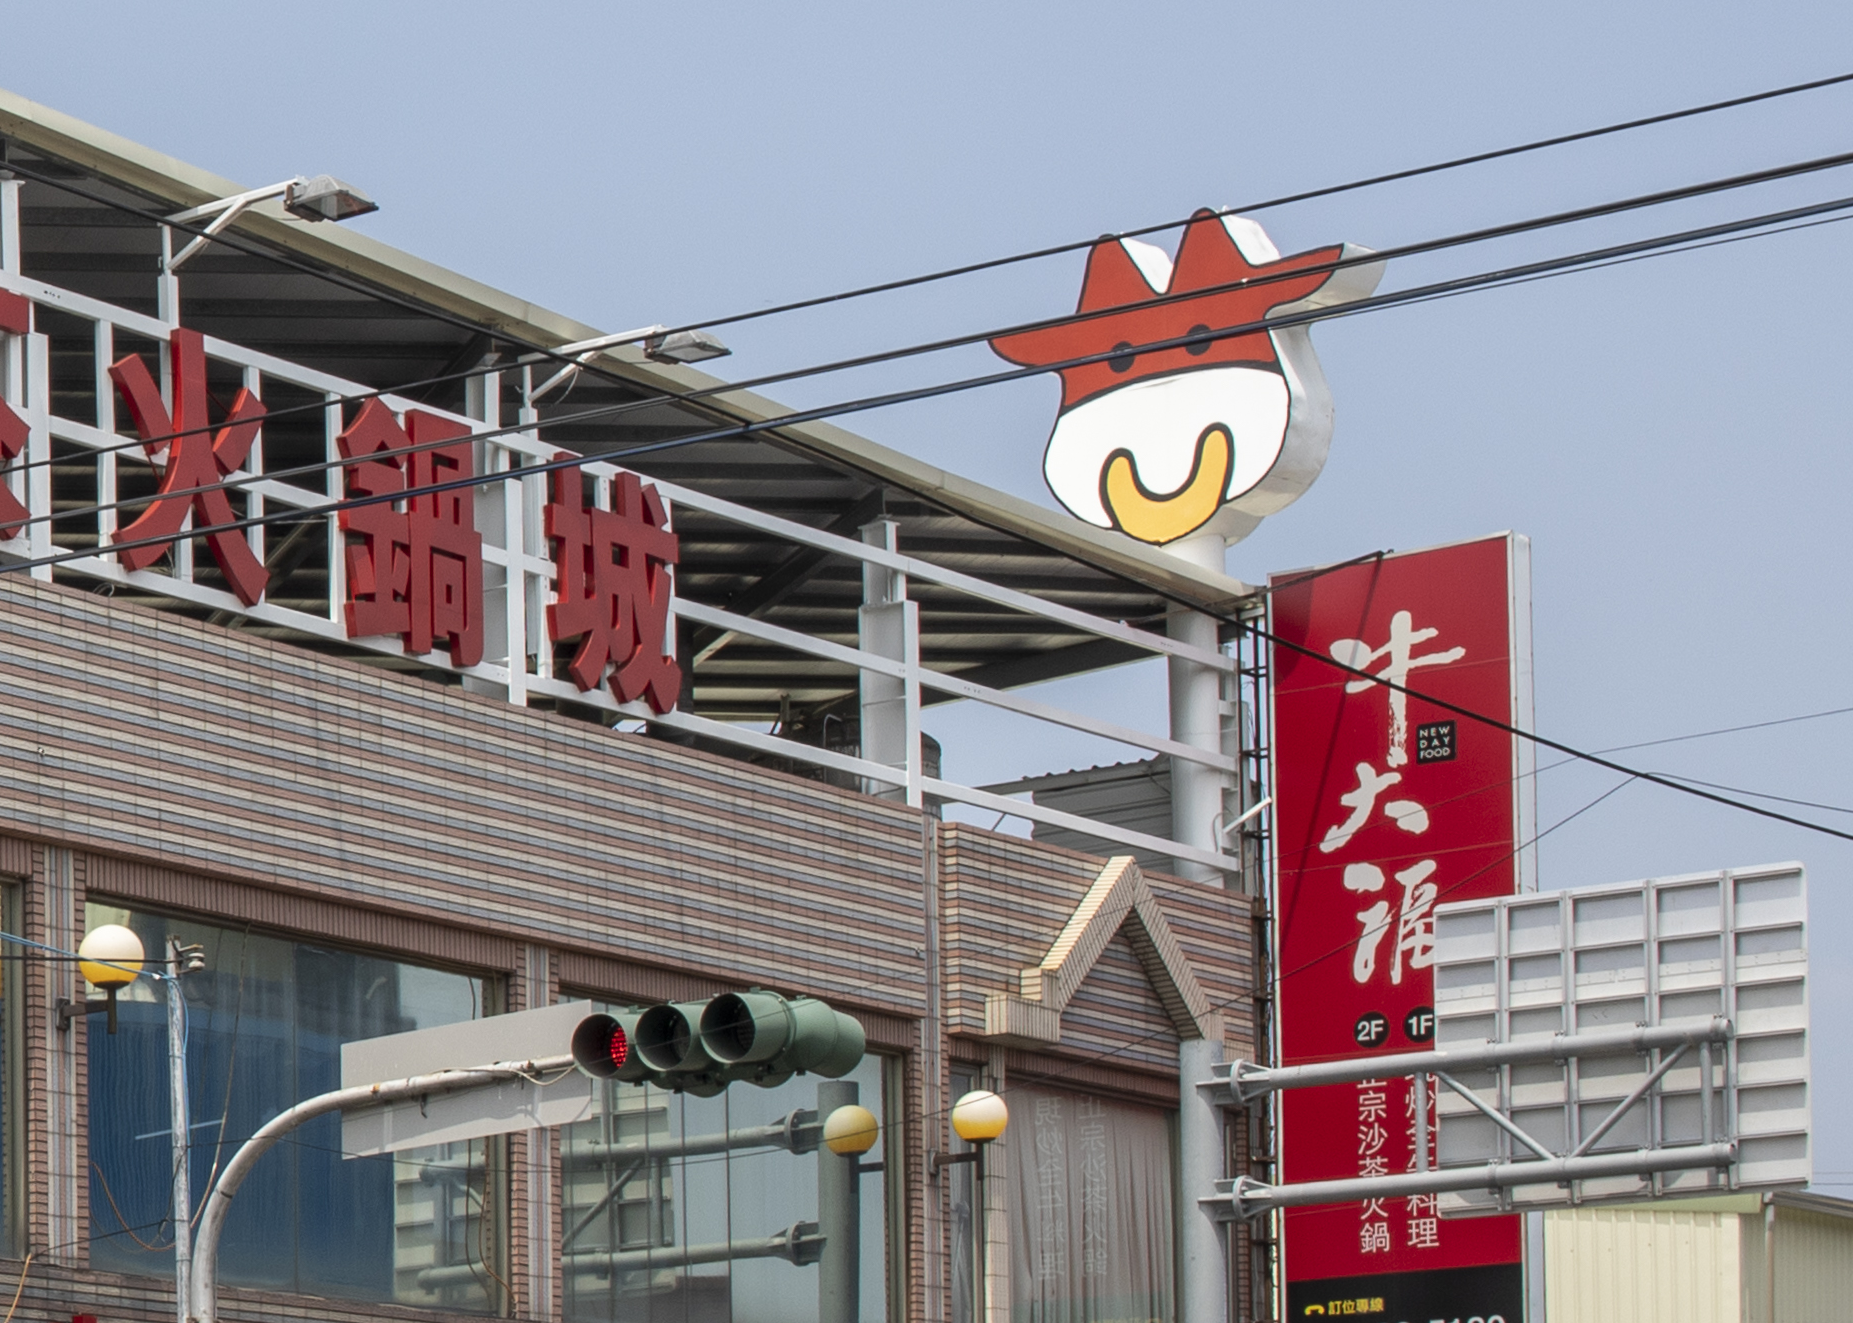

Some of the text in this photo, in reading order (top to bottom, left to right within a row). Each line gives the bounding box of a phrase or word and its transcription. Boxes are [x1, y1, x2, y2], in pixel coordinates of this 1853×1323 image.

[1419, 725, 1451, 739] NEW
[1419, 735, 1451, 749] DAY
[1419, 746, 1451, 760] FOOD
[1356, 1019, 1385, 1042] 2F
[1407, 1013, 1435, 1037] 1F
[1356, 1075, 1391, 1255] 宗沙茶火鍋
[1327, 1298, 1385, 1316] 訂位專線
